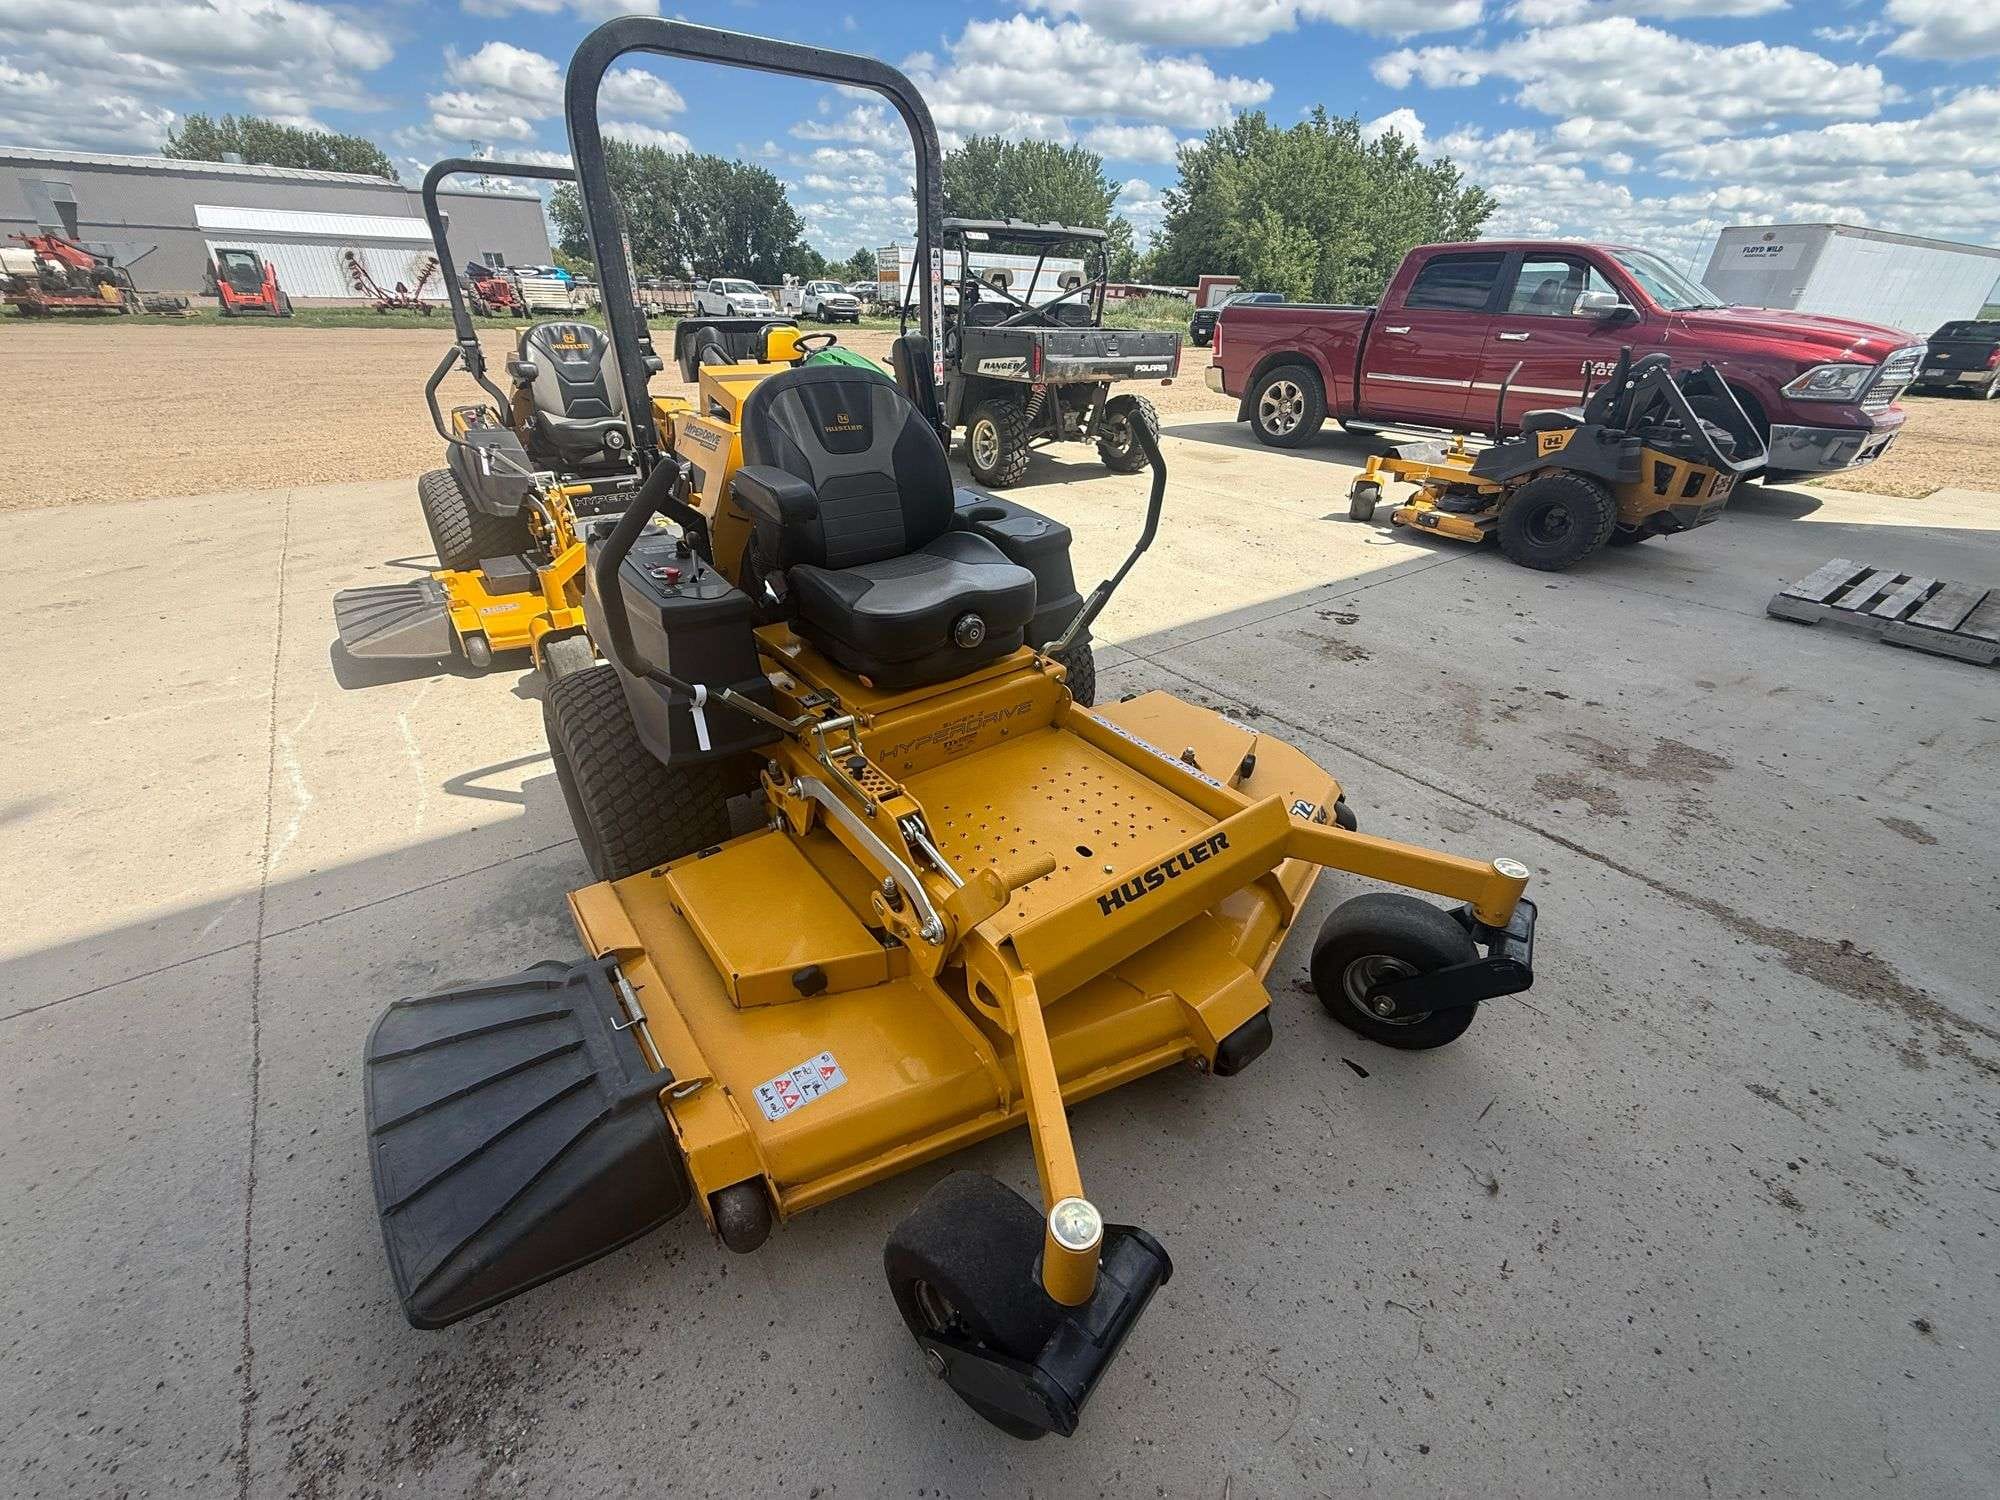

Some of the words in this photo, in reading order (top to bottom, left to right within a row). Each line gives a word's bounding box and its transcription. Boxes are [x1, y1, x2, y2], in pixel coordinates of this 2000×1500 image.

[984, 362, 1021, 370] RANGER
[880, 700, 1034, 762] HYPERDRIVE
[1289, 799, 1316, 820] 72
[1096, 831, 1230, 917] HUSTLER
